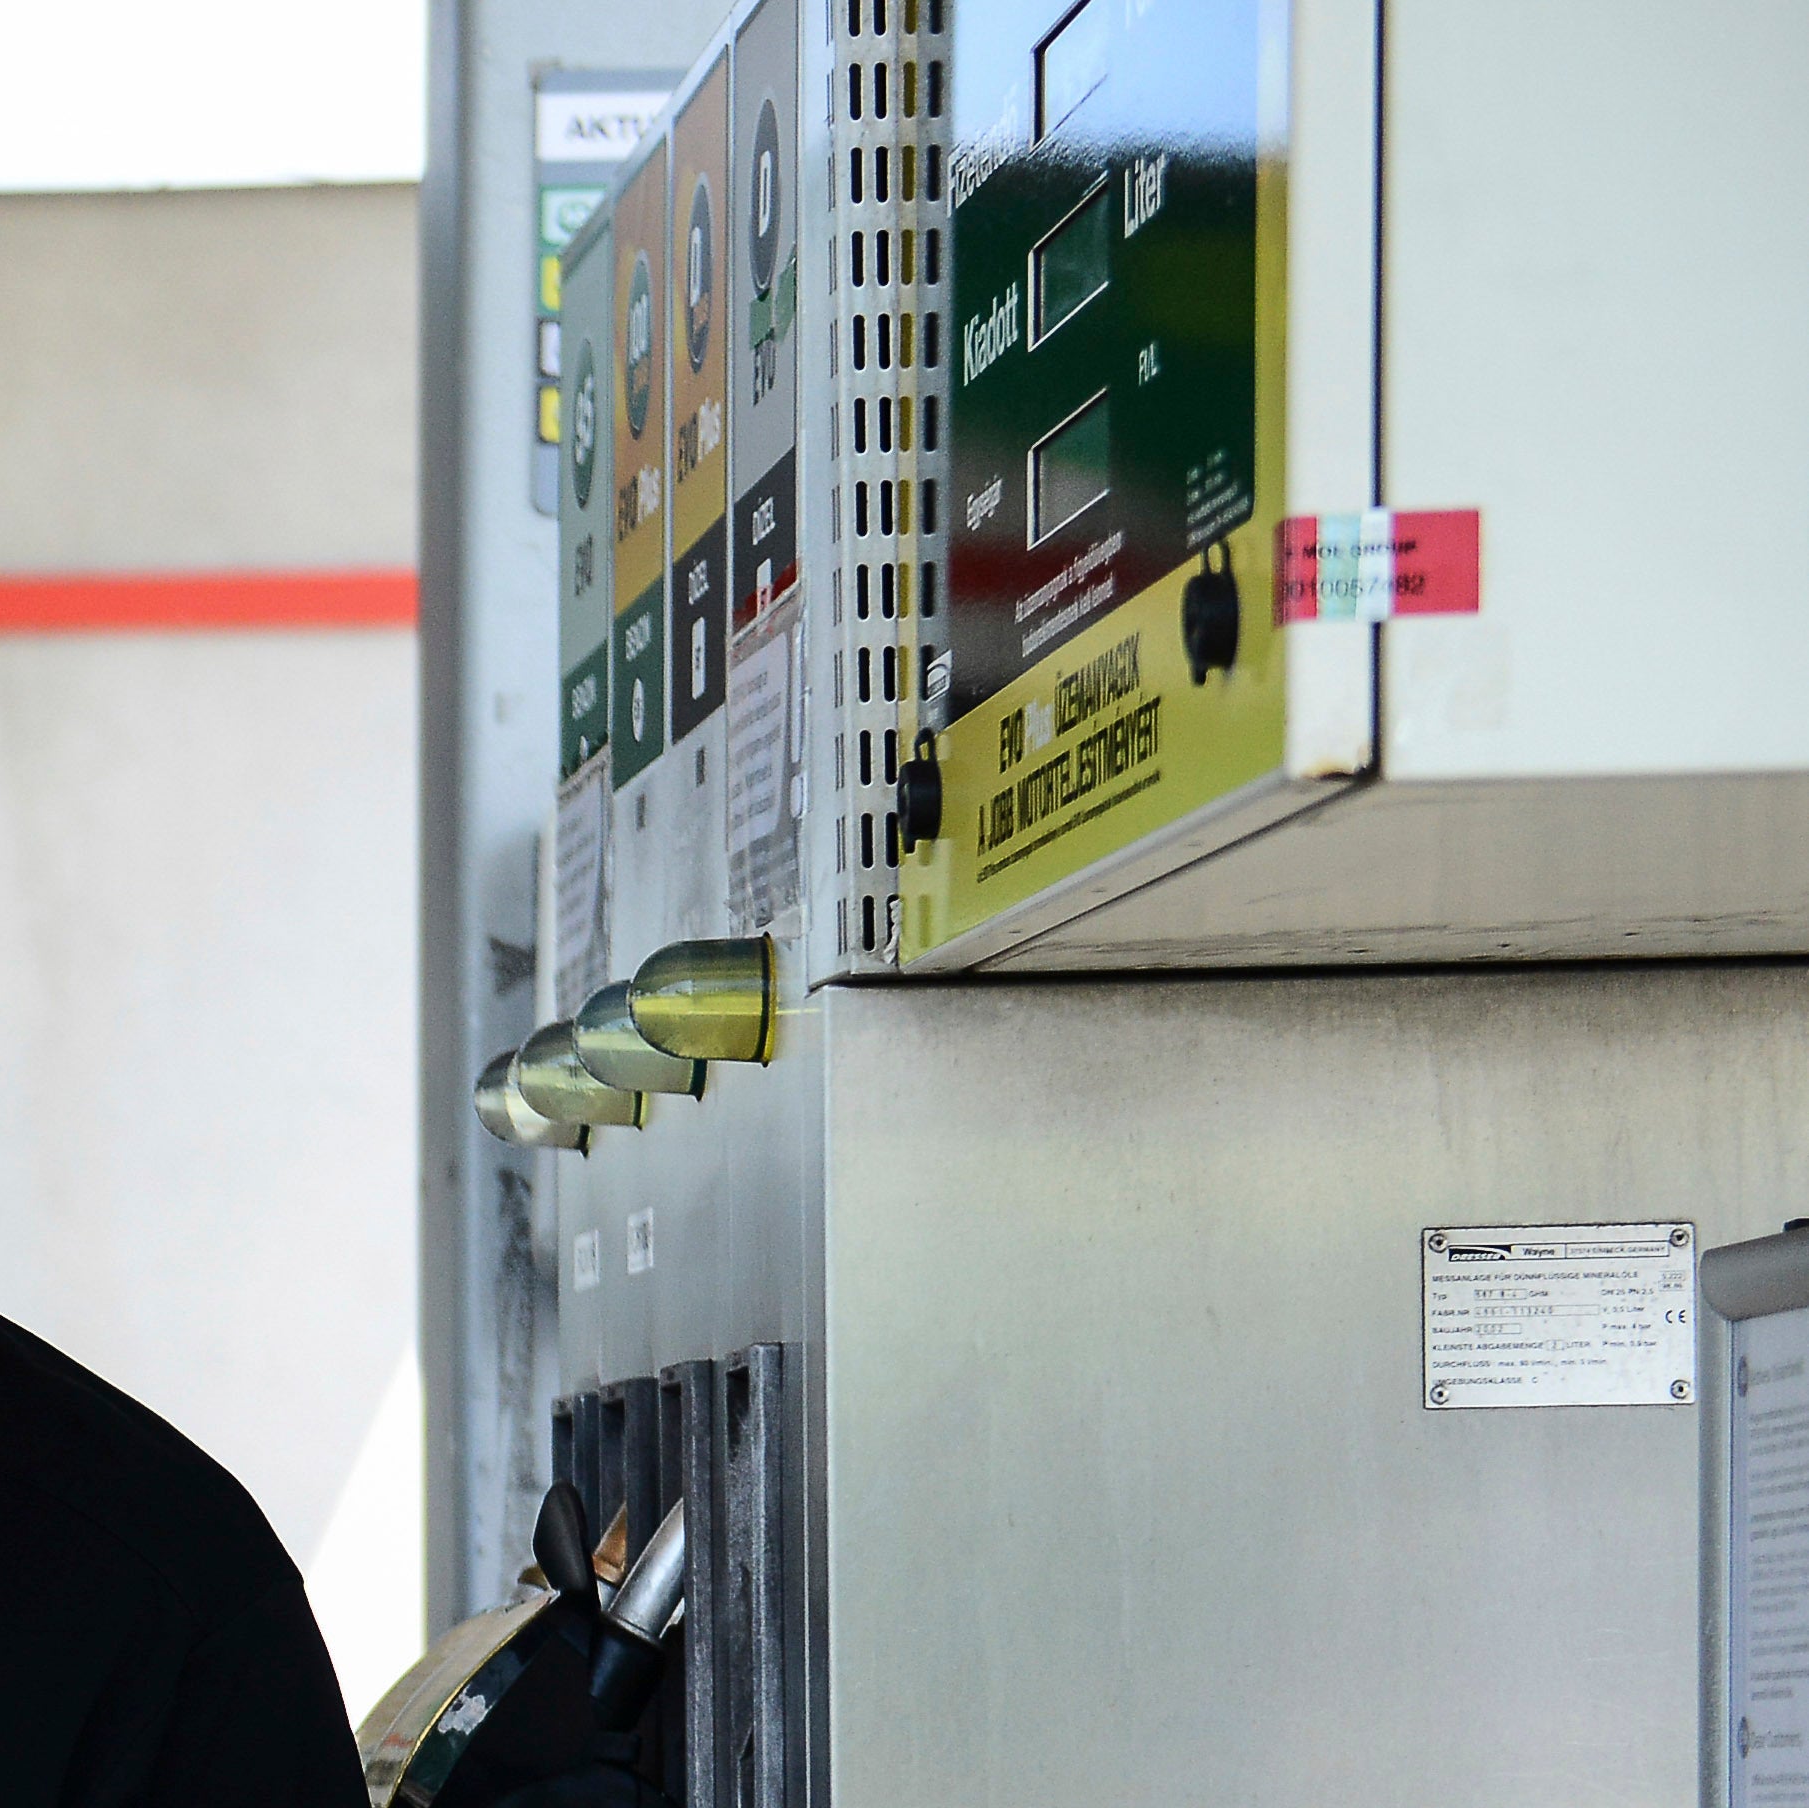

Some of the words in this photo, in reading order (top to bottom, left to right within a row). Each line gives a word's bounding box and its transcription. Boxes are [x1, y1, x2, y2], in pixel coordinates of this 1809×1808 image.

[758, 149, 772, 239] D
[1124, 152, 1167, 239] Liter
[752, 339, 776, 407] EVO
[963, 281, 1019, 387] Kiadott
[999, 706, 1024, 775] EVO
[1664, 1309, 1687, 1324] CE
